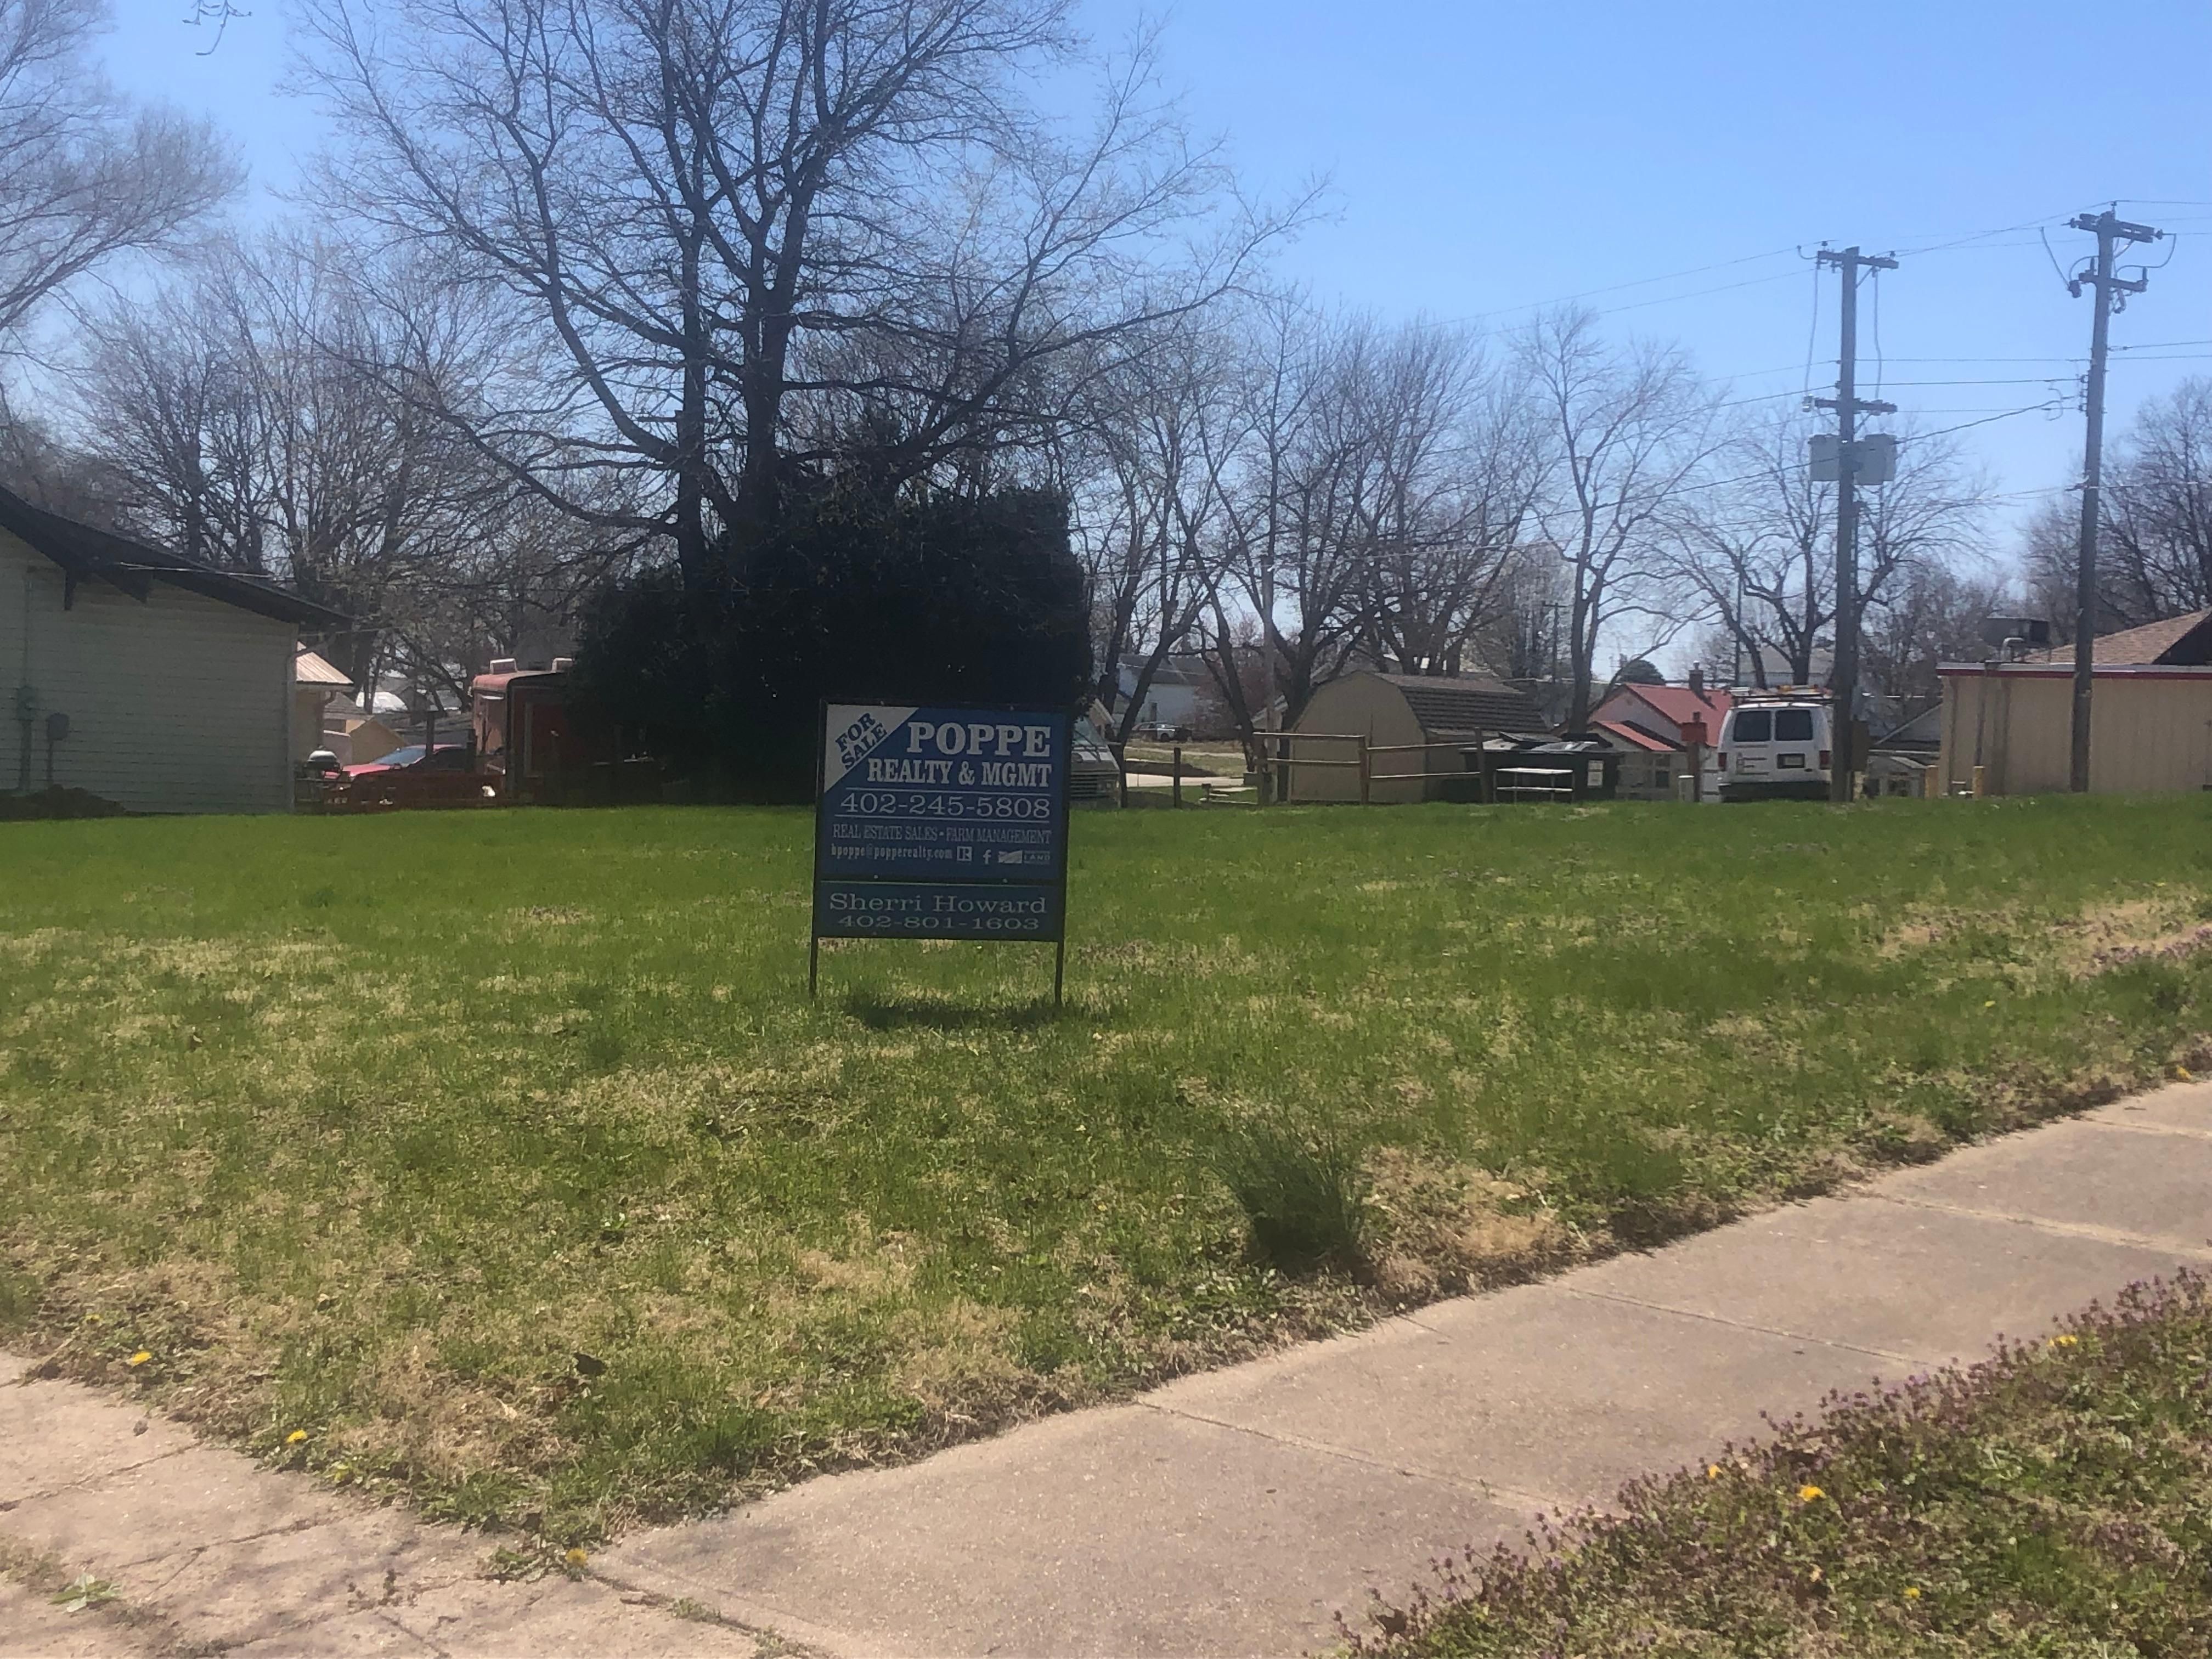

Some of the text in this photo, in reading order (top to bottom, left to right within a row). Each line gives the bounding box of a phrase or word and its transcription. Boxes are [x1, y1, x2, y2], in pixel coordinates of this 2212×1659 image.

[835, 713, 875, 752] FOR
[842, 723, 887, 769] SALE
[906, 723, 1051, 757] POPPE
[867, 758, 1052, 787] REALTY & MGMT
[840, 793, 1050, 818] 402-245-5808
[833, 824, 1052, 844] REAL ESTATE SALES FARM MANAGEMENT
[830, 893, 1047, 913] Sherri Howard
[838, 915, 1039, 930] 402-801-1603
